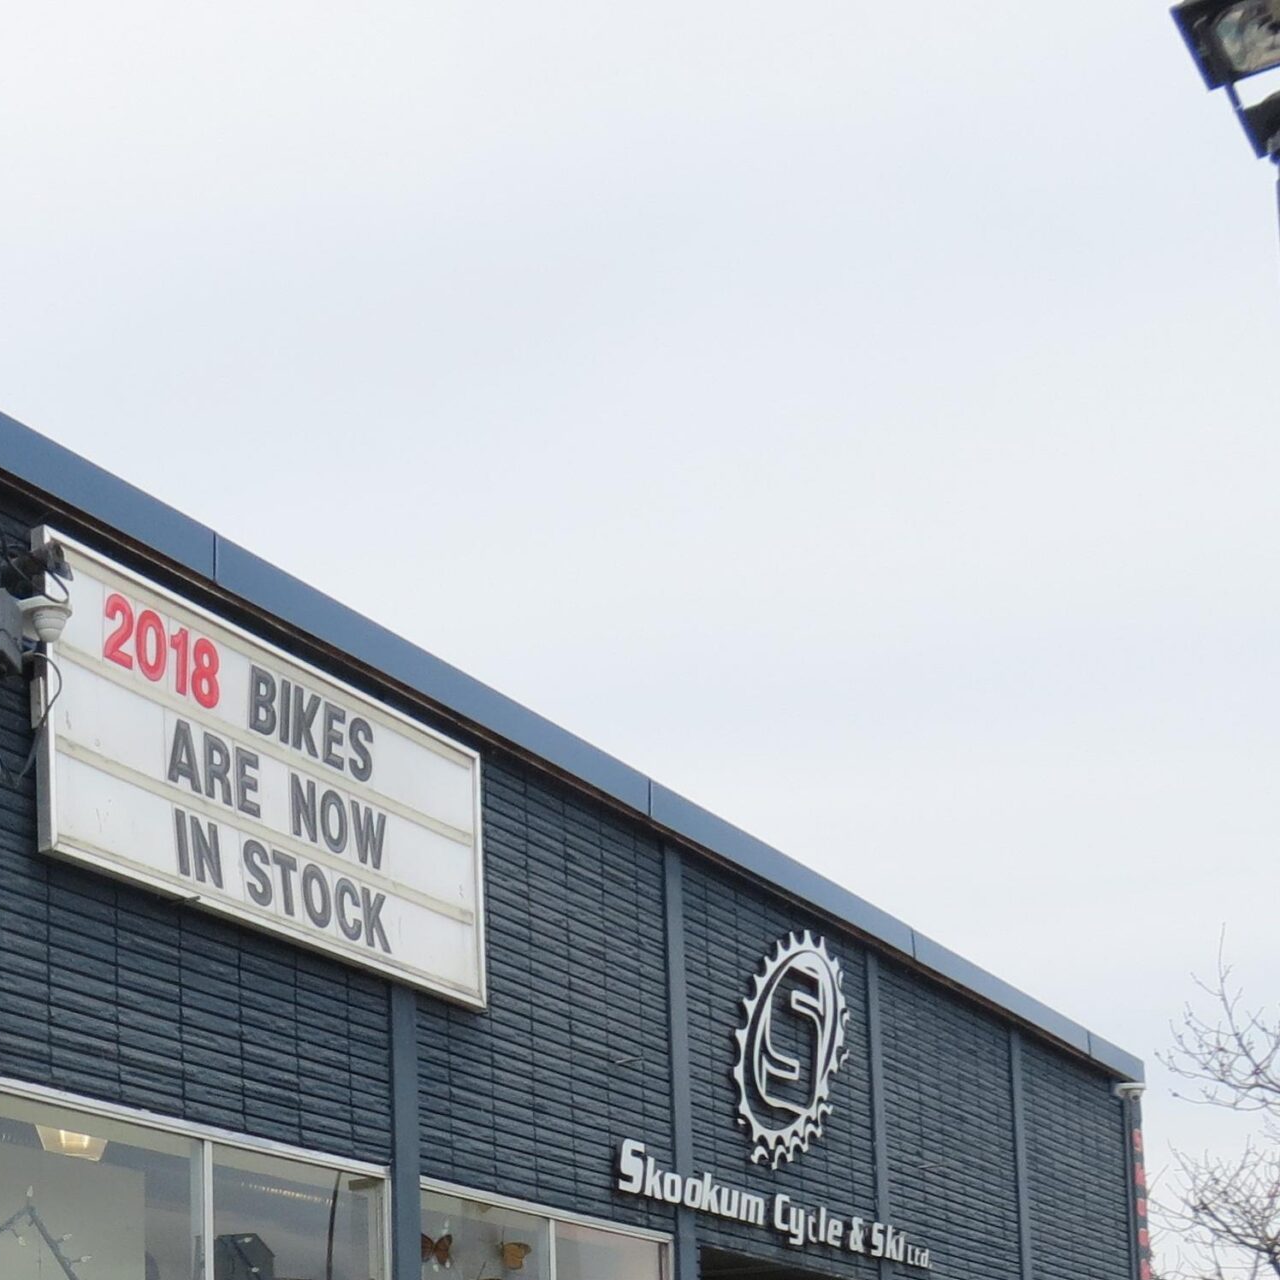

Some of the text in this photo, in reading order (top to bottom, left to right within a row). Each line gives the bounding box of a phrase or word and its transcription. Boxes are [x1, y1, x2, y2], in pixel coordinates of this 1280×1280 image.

[102, 592, 375, 783] 2018 BIKES
[166, 719, 387, 870] ARE NOW
[173, 808, 393, 955] IN STOCK
[618, 1138, 765, 1226] Skookum
[773, 1193, 843, 1246] Cycle
[849, 1216, 865, 1254] &
